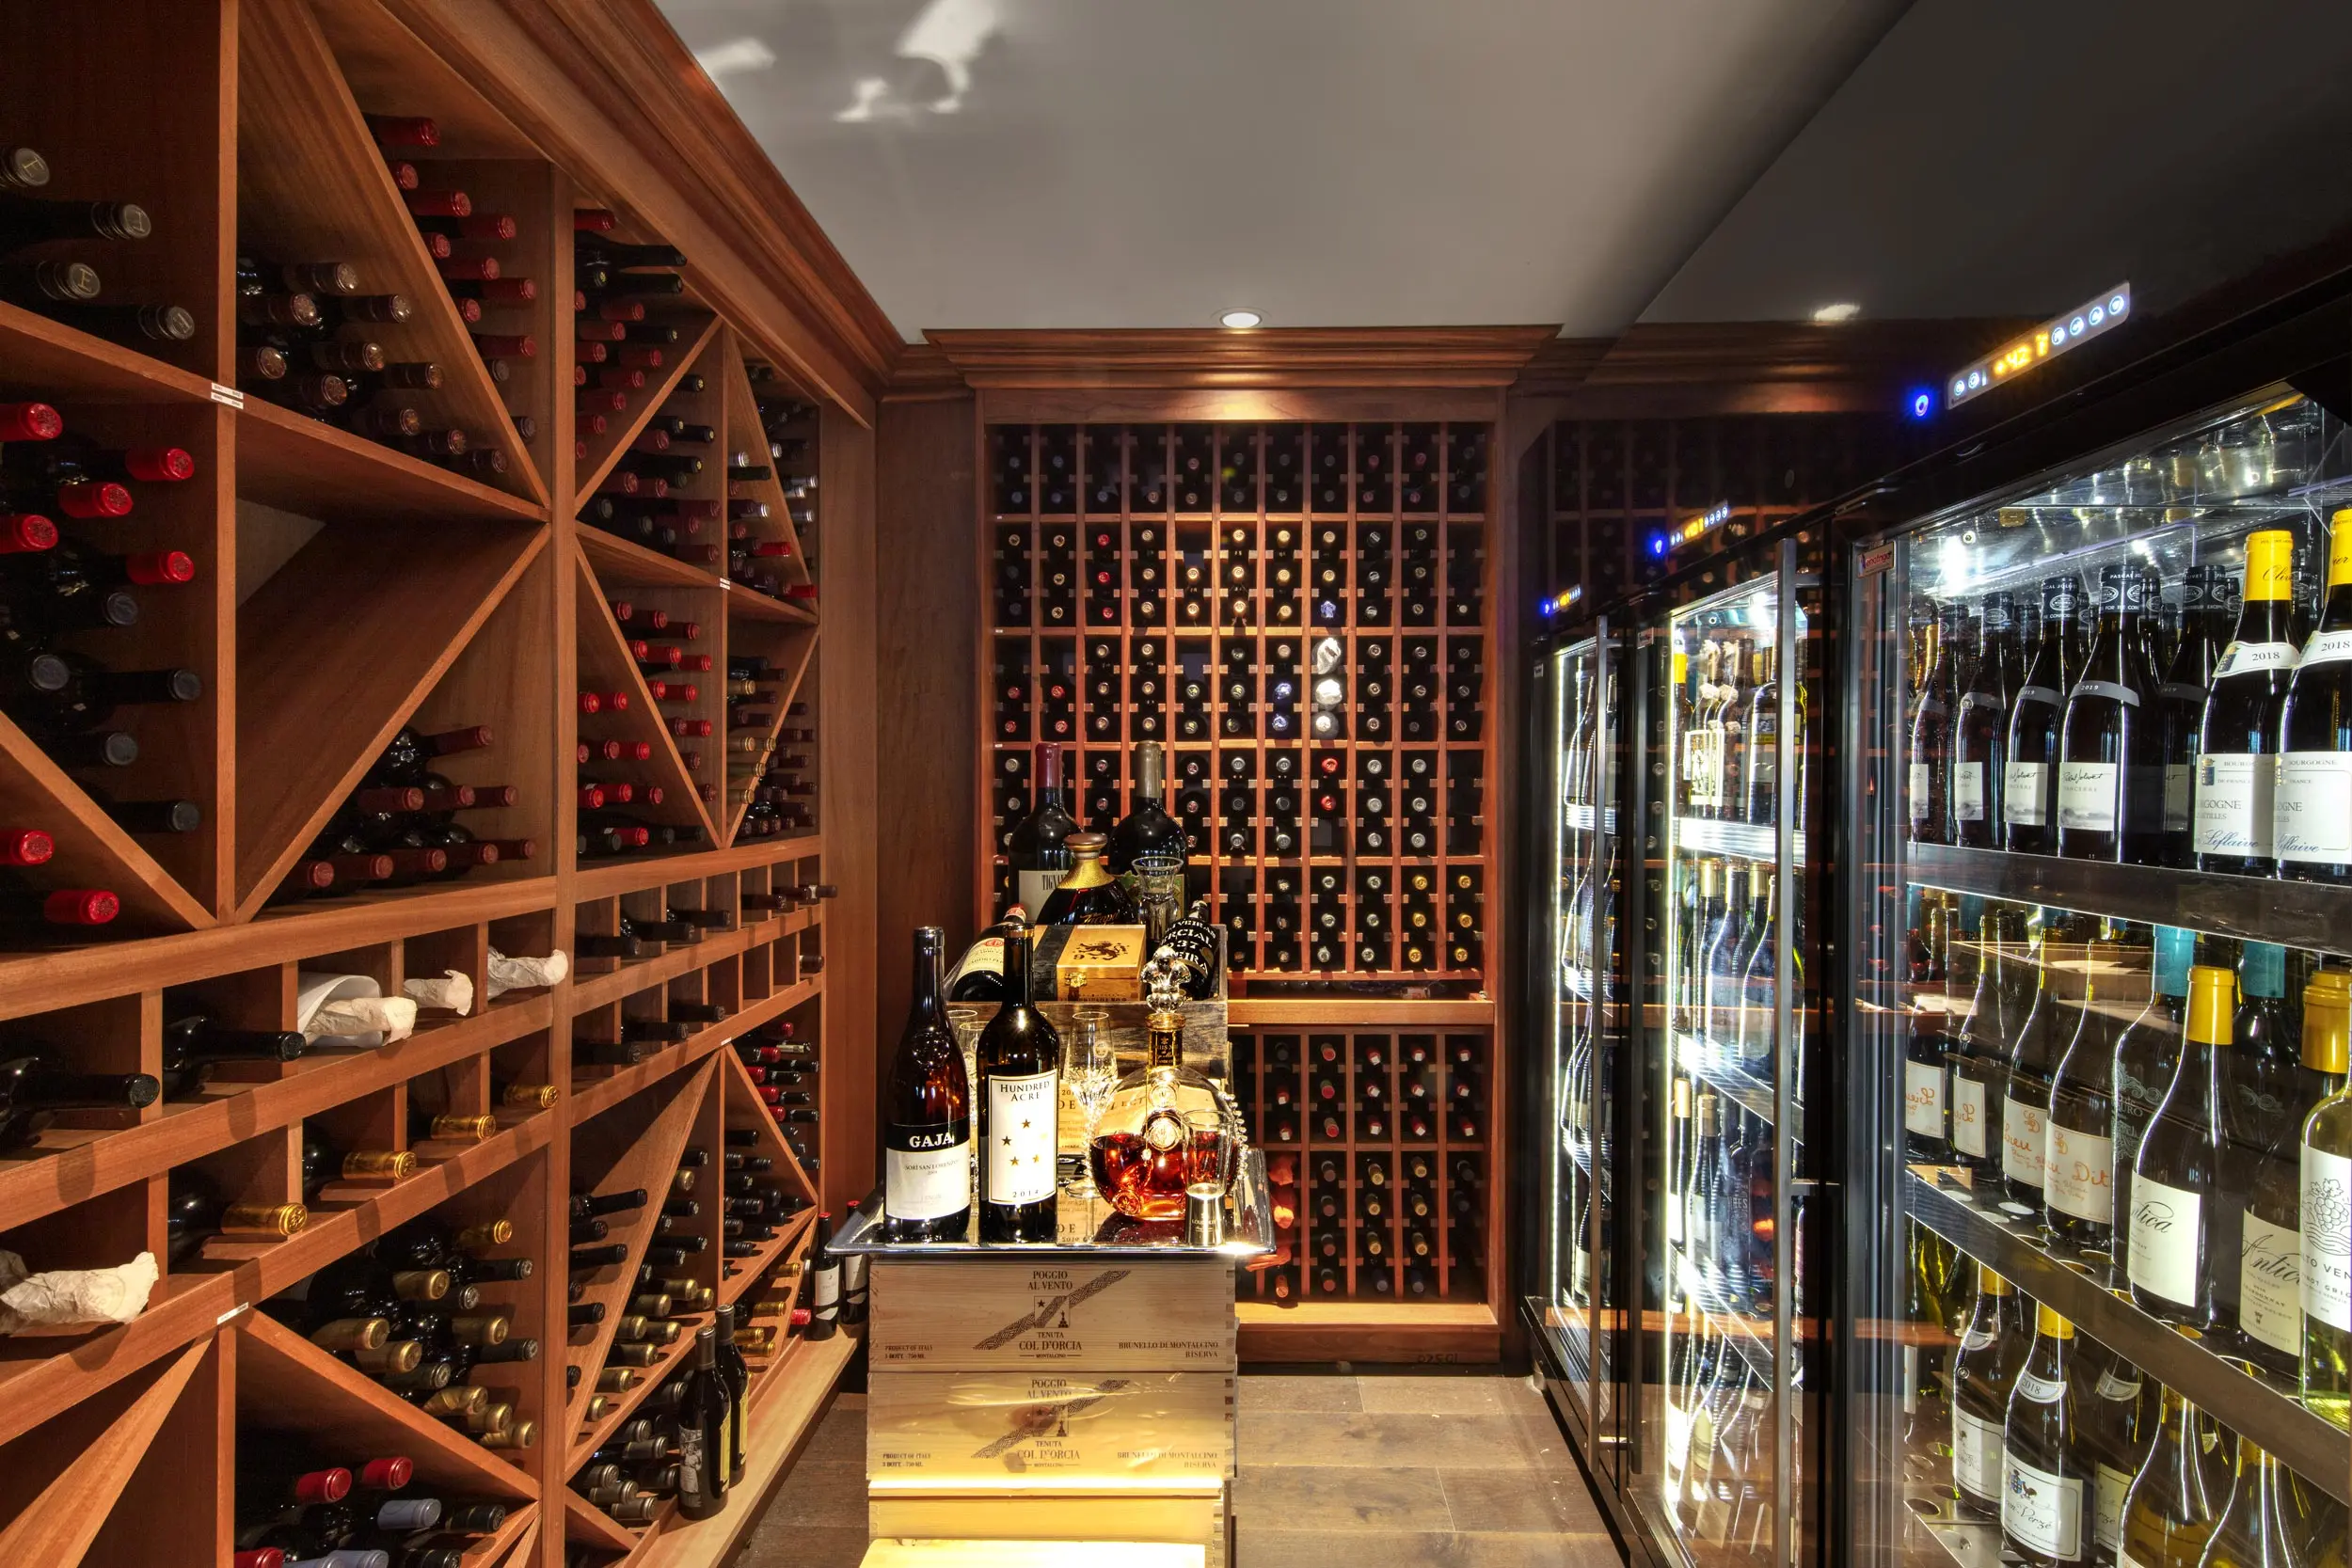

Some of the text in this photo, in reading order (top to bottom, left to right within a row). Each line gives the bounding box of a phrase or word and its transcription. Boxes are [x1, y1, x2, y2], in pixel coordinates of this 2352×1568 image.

[2321, 640, 2350, 652] 2018
[2252, 651, 2280, 661] 2018
[1000, 1080, 1050, 1093] HUNDRED
[1010, 1091, 1040, 1102] ACRE
[909, 1132, 955, 1148] GAJA
[2072, 1161, 2109, 1187] Dit
[1032, 1270, 1068, 1280] POGGIO
[1027, 1280, 1073, 1291] AL VENTO
[1019, 1340, 1040, 1351] COL
[1119, 1341, 1158, 1350] BRUNELLO
[1031, 1379, 1067, 1388] POGGIO
[2021, 1378, 2042, 1394] 2018
[1026, 1389, 1039, 1399] AL
[1017, 1449, 1037, 1459] COL
